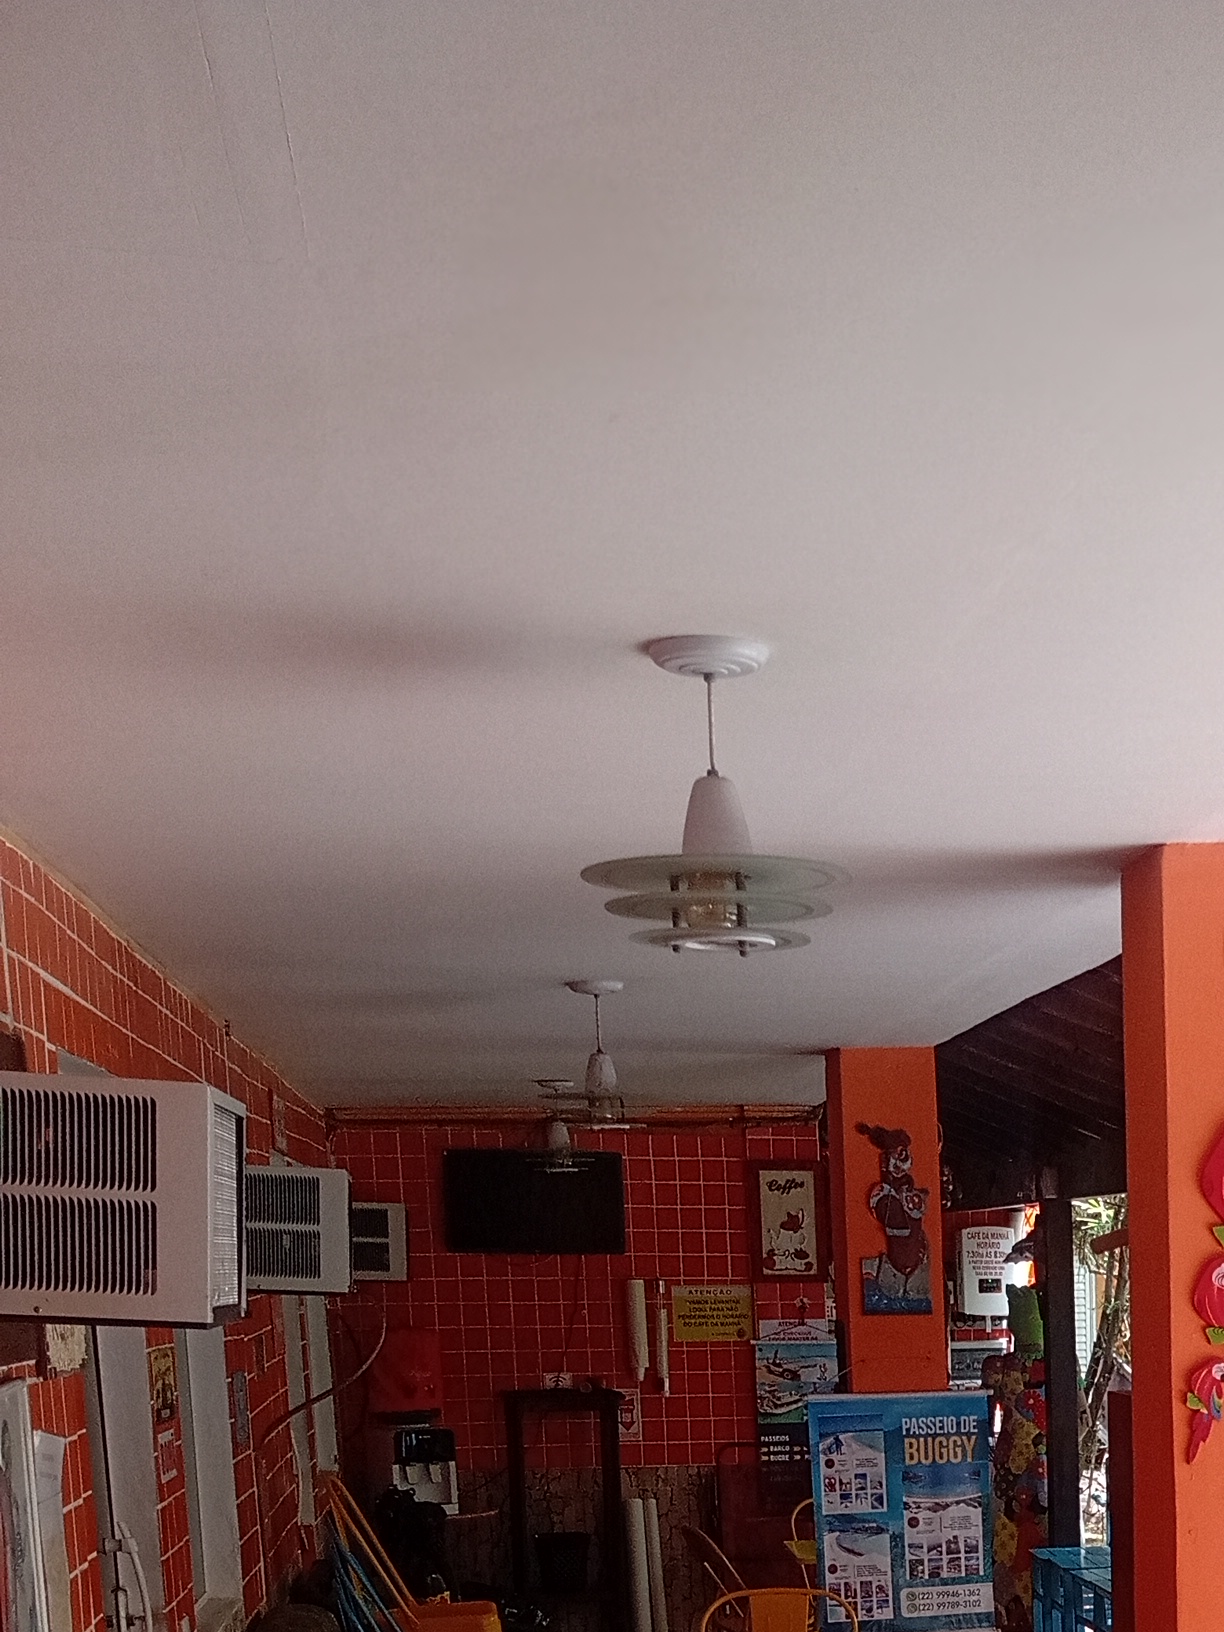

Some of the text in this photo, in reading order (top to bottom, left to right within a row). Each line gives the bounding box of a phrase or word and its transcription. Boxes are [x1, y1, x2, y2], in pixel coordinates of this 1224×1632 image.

[766, 1178, 804, 1195] Coffee
[902, 1416, 978, 1435] PASSEIO DE
[904, 1435, 977, 1466] BUGGY
[918, 1588, 981, 1600] (22) 99946-1362
[918, 1600, 982, 1611] (22) 99789-3102
